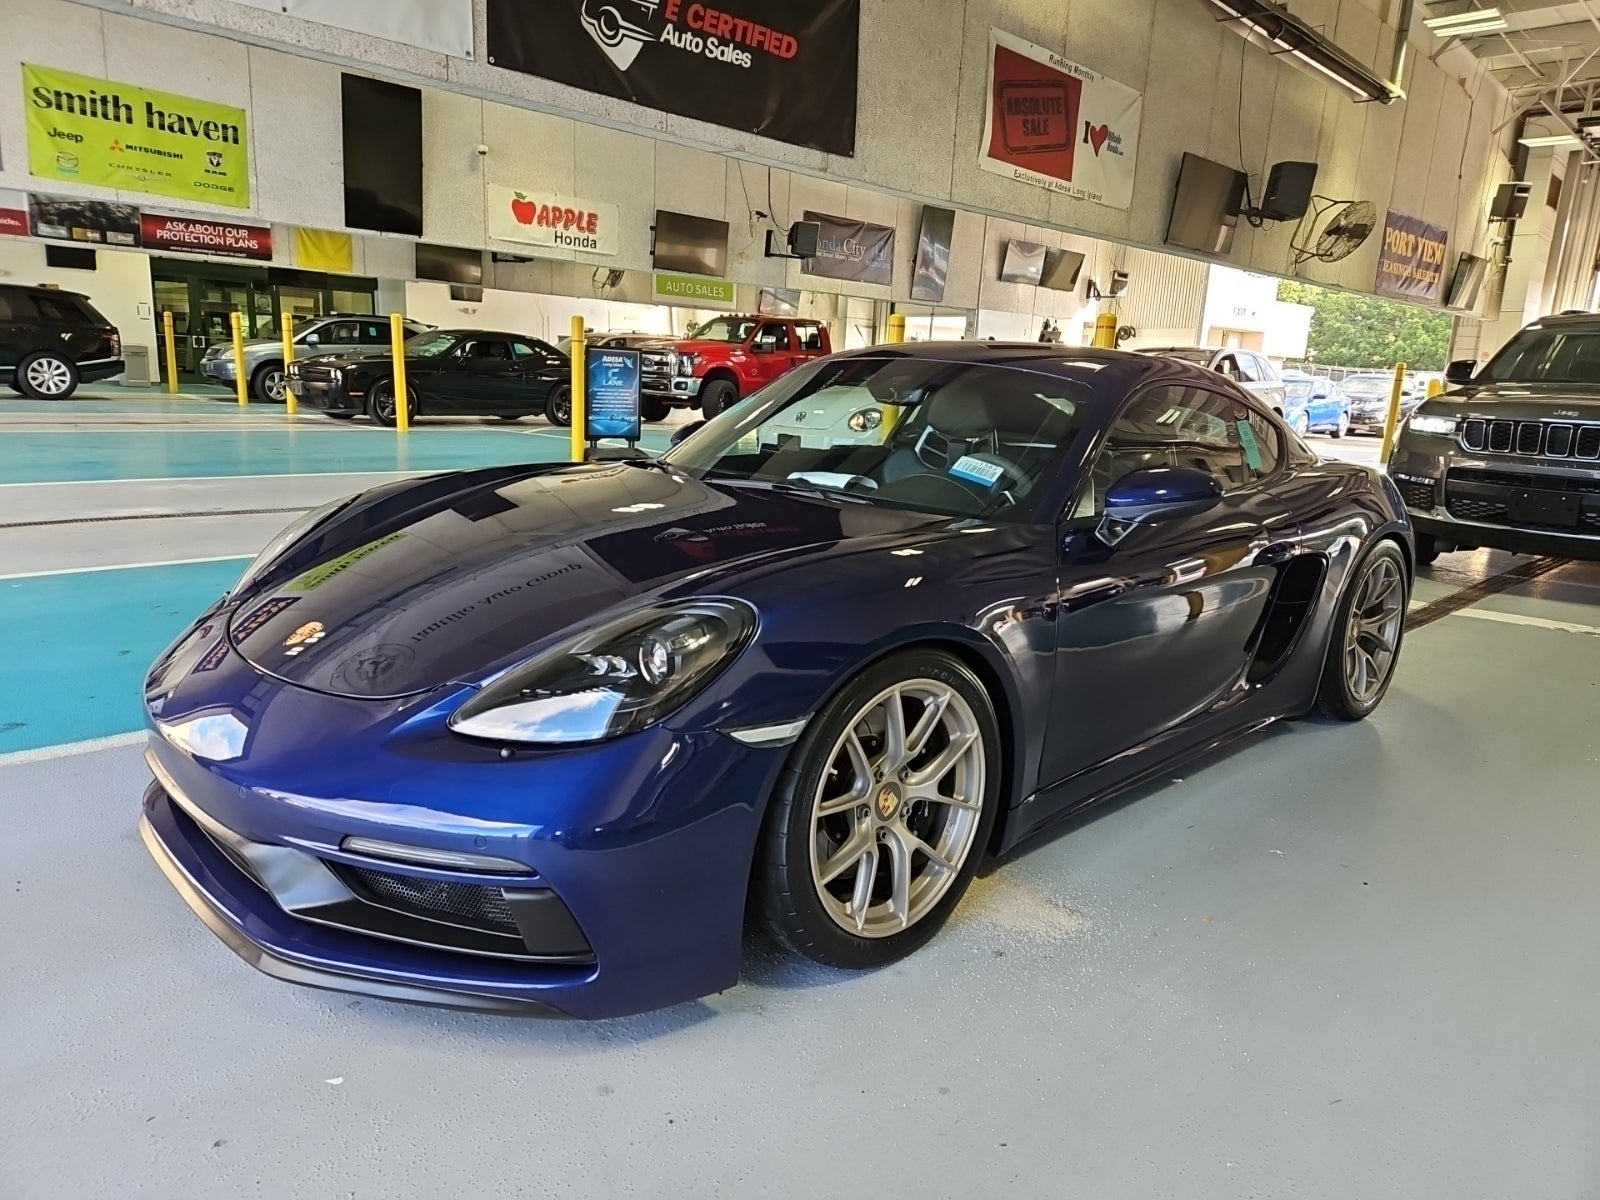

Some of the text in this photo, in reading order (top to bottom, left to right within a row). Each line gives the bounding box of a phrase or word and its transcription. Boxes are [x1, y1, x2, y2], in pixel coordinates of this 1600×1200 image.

[686, 3, 798, 59] CERTIFIED
[659, 23, 752, 68] Auto Sales
[1048, 54, 1095, 82] Running Monthly
[1006, 96, 1063, 116] ABSOLUTE
[145, 101, 240, 145] haven
[1022, 118, 1050, 137] SALE
[47, 127, 84, 144] Jeep
[125, 143, 183, 160] MITSUBISHI
[108, 162, 172, 177] CHRYSLER
[204, 168, 227, 177] RAM
[193, 181, 235, 193] DODGE
[1013, 169, 1047, 188] Exclusively
[1054, 181, 1071, 194] Adesa
[1072, 186, 1086, 198] Long
[537, 204, 599, 235] APPLE
[156, 229, 259, 250] PROTECTION PLANS
[165, 221, 249, 239] ASK ABOUT OUR
[554, 230, 597, 249] Honda
[816, 235, 866, 261] onda City
[1384, 226, 1415, 258] PORT
[665, 280, 724, 298] AUTO SALES
[1553, 408, 1580, 417] Jeep
